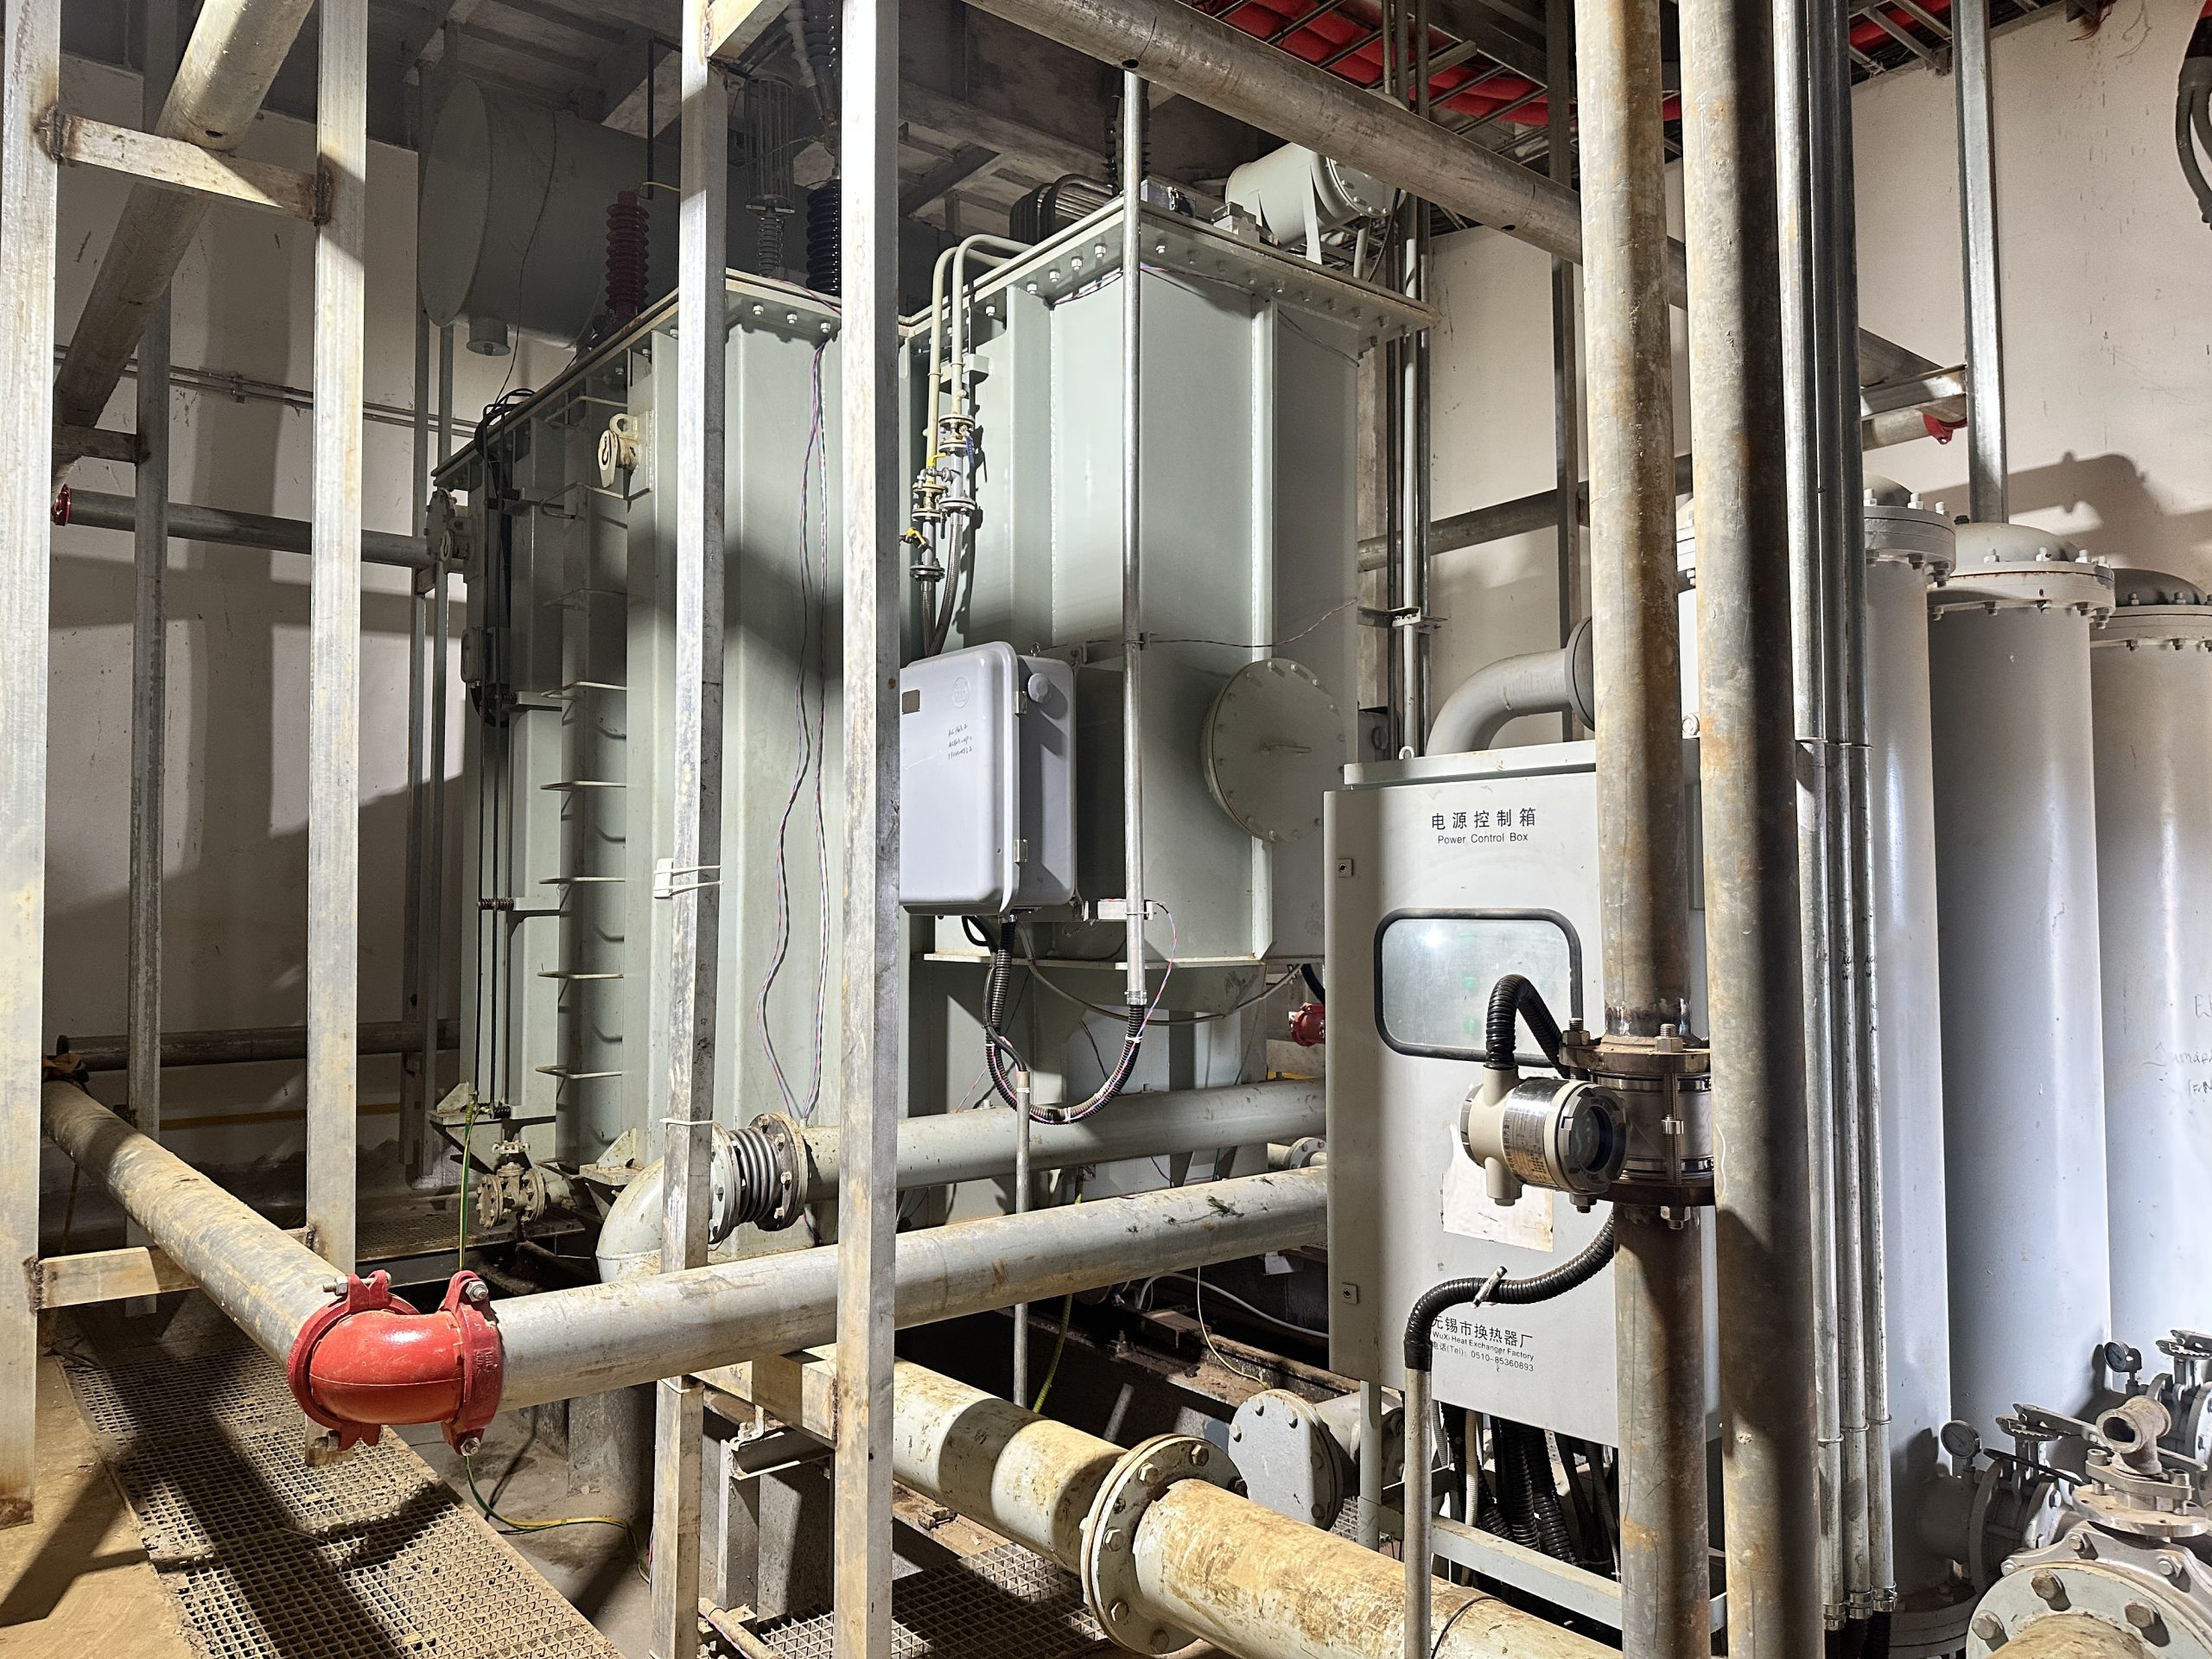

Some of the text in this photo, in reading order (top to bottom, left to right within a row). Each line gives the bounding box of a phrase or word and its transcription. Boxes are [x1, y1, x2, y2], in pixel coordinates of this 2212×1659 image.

[1431, 807, 1536, 830] 电源控制箱
[1437, 832, 1529, 844] Power Control Box
[1432, 1315, 1534, 1348] 无锡市换热器厂
[1452, 1335, 1468, 1344] Heat
[1469, 1339, 1505, 1354] Exchanger
[1507, 1349, 1535, 1362] Factory
[1471, 1351, 1534, 1372] 0510-85360893
